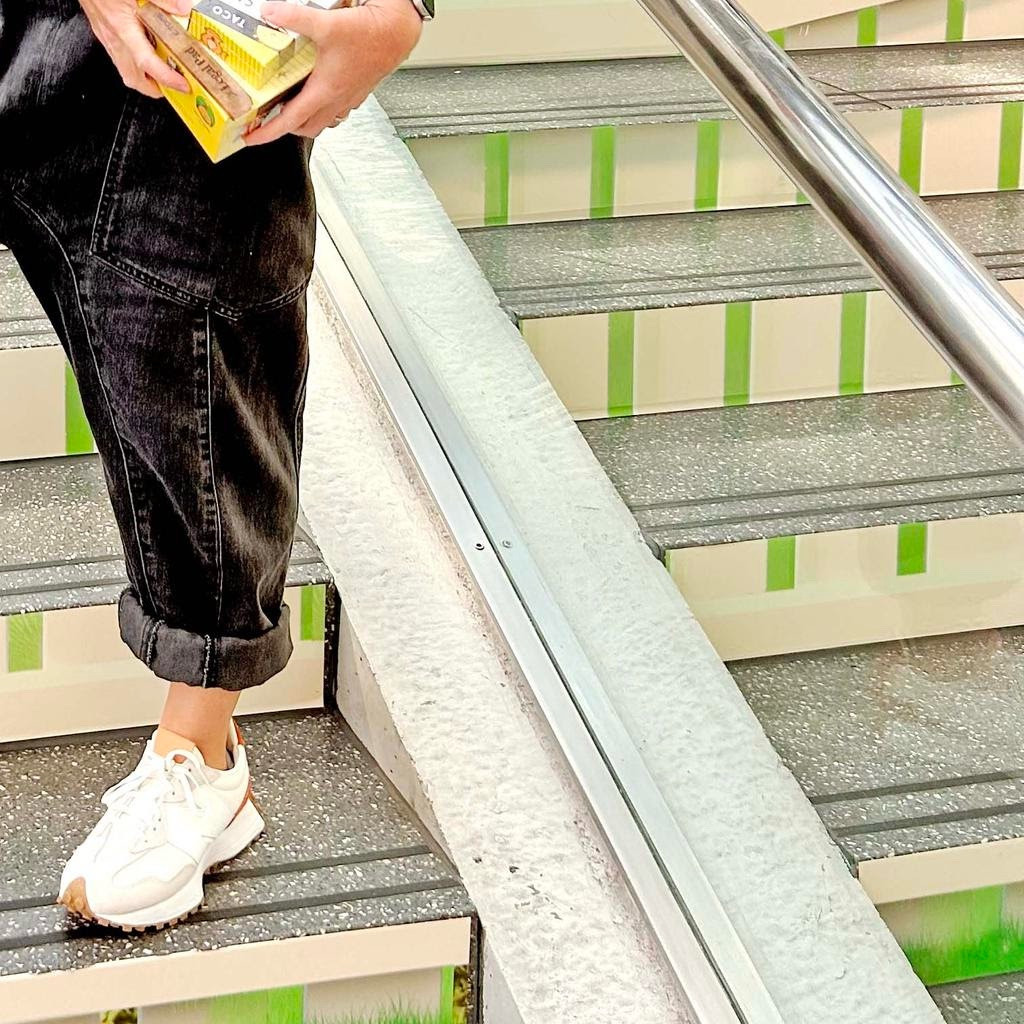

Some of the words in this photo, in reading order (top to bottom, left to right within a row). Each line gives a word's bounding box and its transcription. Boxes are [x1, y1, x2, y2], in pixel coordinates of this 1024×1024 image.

[212, 5, 246, 28] TACO
[184, 45, 205, 67] Pad
[200, 64, 231, 92] Legal
